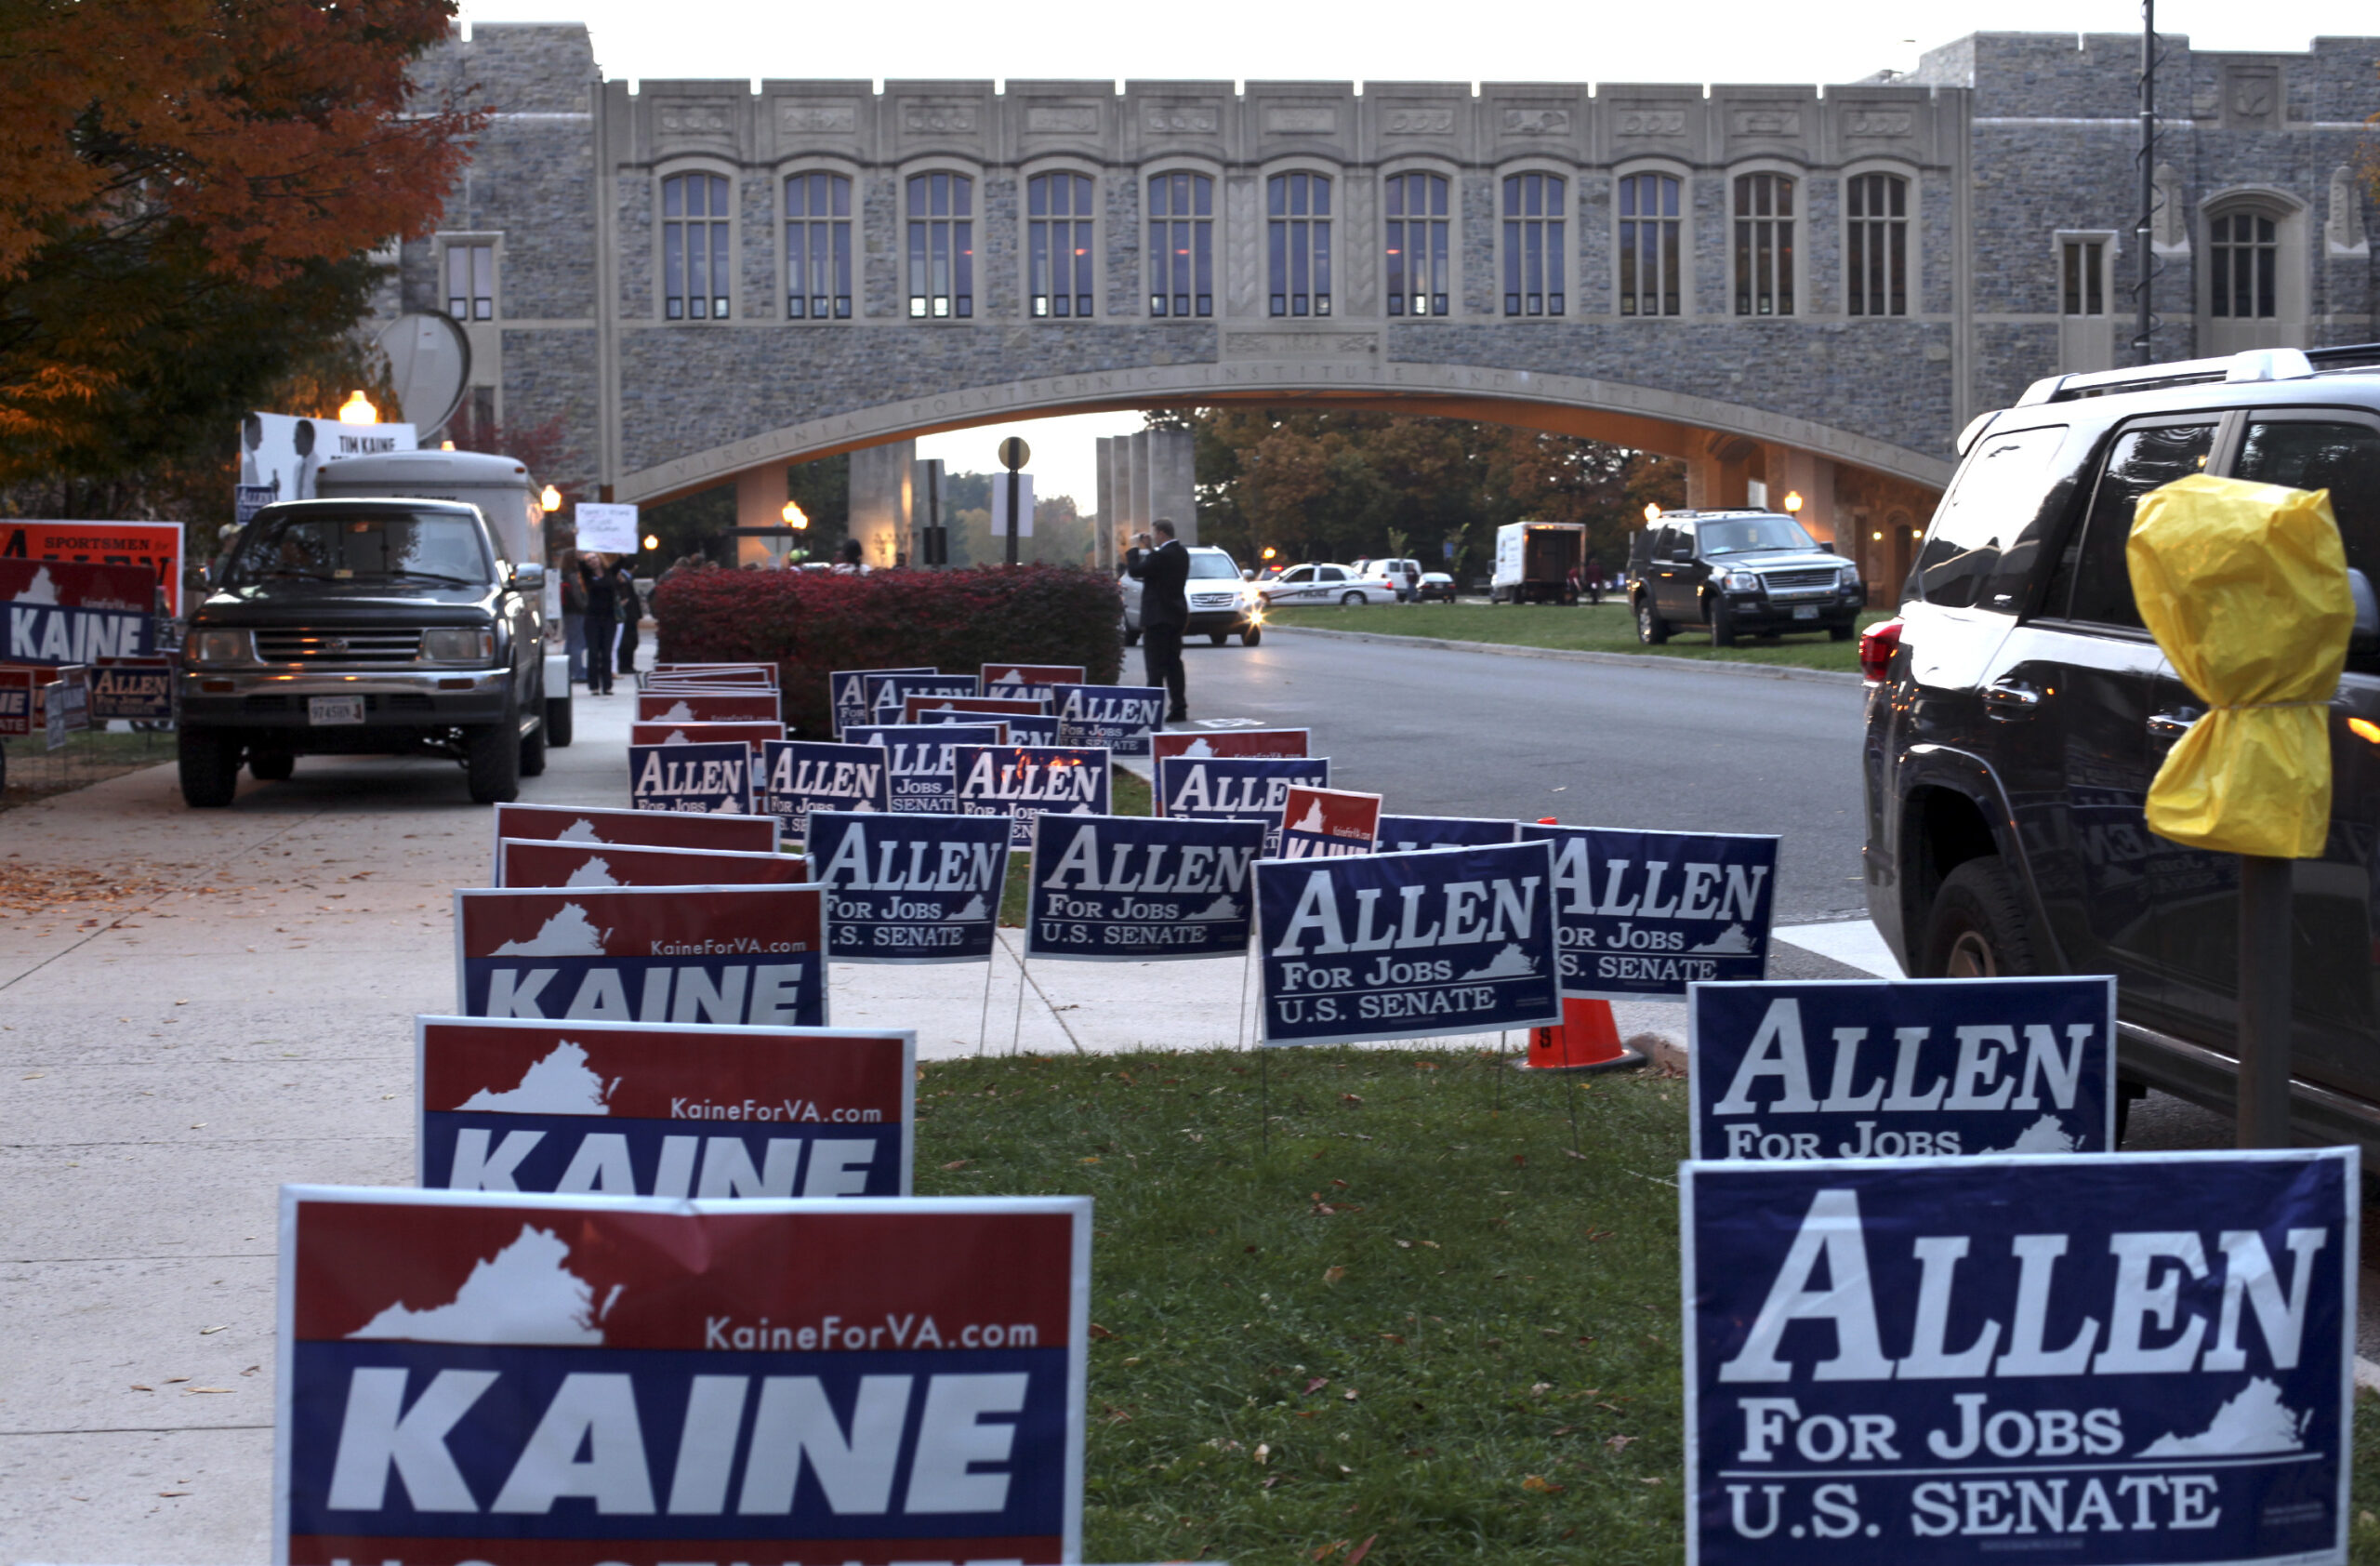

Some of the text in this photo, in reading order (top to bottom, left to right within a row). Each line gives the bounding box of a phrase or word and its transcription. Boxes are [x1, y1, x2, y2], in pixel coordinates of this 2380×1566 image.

[674, 365, 1906, 474] VIRGINIA POLYTECHNIC INSTITUTE AND STATE UNIVERSITY
[338, 435, 395, 454] TIM KAINE
[45, 537, 151, 551] SPORTSMEN
[10, 607, 143, 663] KAINE
[93, 670, 169, 696] ALLEN
[1061, 689, 1161, 724] ALLEN
[1061, 724, 1124, 737] FOR JOBS
[1086, 738, 1139, 750] SENATE
[634, 750, 744, 797] ALLEN
[770, 747, 881, 799] ALLEN
[896, 778, 943, 794] JOBS
[959, 751, 1103, 802] ALLEN
[638, 798, 707, 813] FOR JOBS
[771, 795, 835, 814] FOR JOBS
[963, 803, 997, 816] FOR
[818, 822, 1003, 892] ALLEN
[1041, 824, 1257, 894] ALLEN
[1554, 837, 1769, 922] ALLEN
[827, 895, 943, 920] FOR JOBS
[1046, 894, 1180, 921] FOR JOBS
[1272, 869, 1542, 957] ALLEN
[651, 937, 807, 956] KaineForVA.com
[827, 925, 965, 947] .S. SENATE
[1041, 922, 1094, 944] U.S.
[1104, 925, 1208, 945] SENATE
[1557, 922, 1685, 950] OR JOBS
[1280, 956, 1453, 991] FOR JOBS
[1597, 957, 1718, 981] SENATE
[486, 963, 803, 1026] KAINE
[1277, 998, 1347, 1023] U.S.
[1358, 987, 1498, 1019] SENATE
[1712, 998, 2095, 1116] ALLEN
[670, 1097, 882, 1123] KaineForVA.com
[1724, 1121, 1963, 1160] FOR JOBS
[448, 1128, 877, 1198] KAINE
[1718, 1188, 2328, 1383] ALLEN
[705, 1315, 1038, 1352] KaineForVA.com
[326, 1367, 1031, 1517] KAINE
[1738, 1393, 2125, 1464] FOR JOBS
[1726, 1474, 2223, 1539] U.S. SENATE
